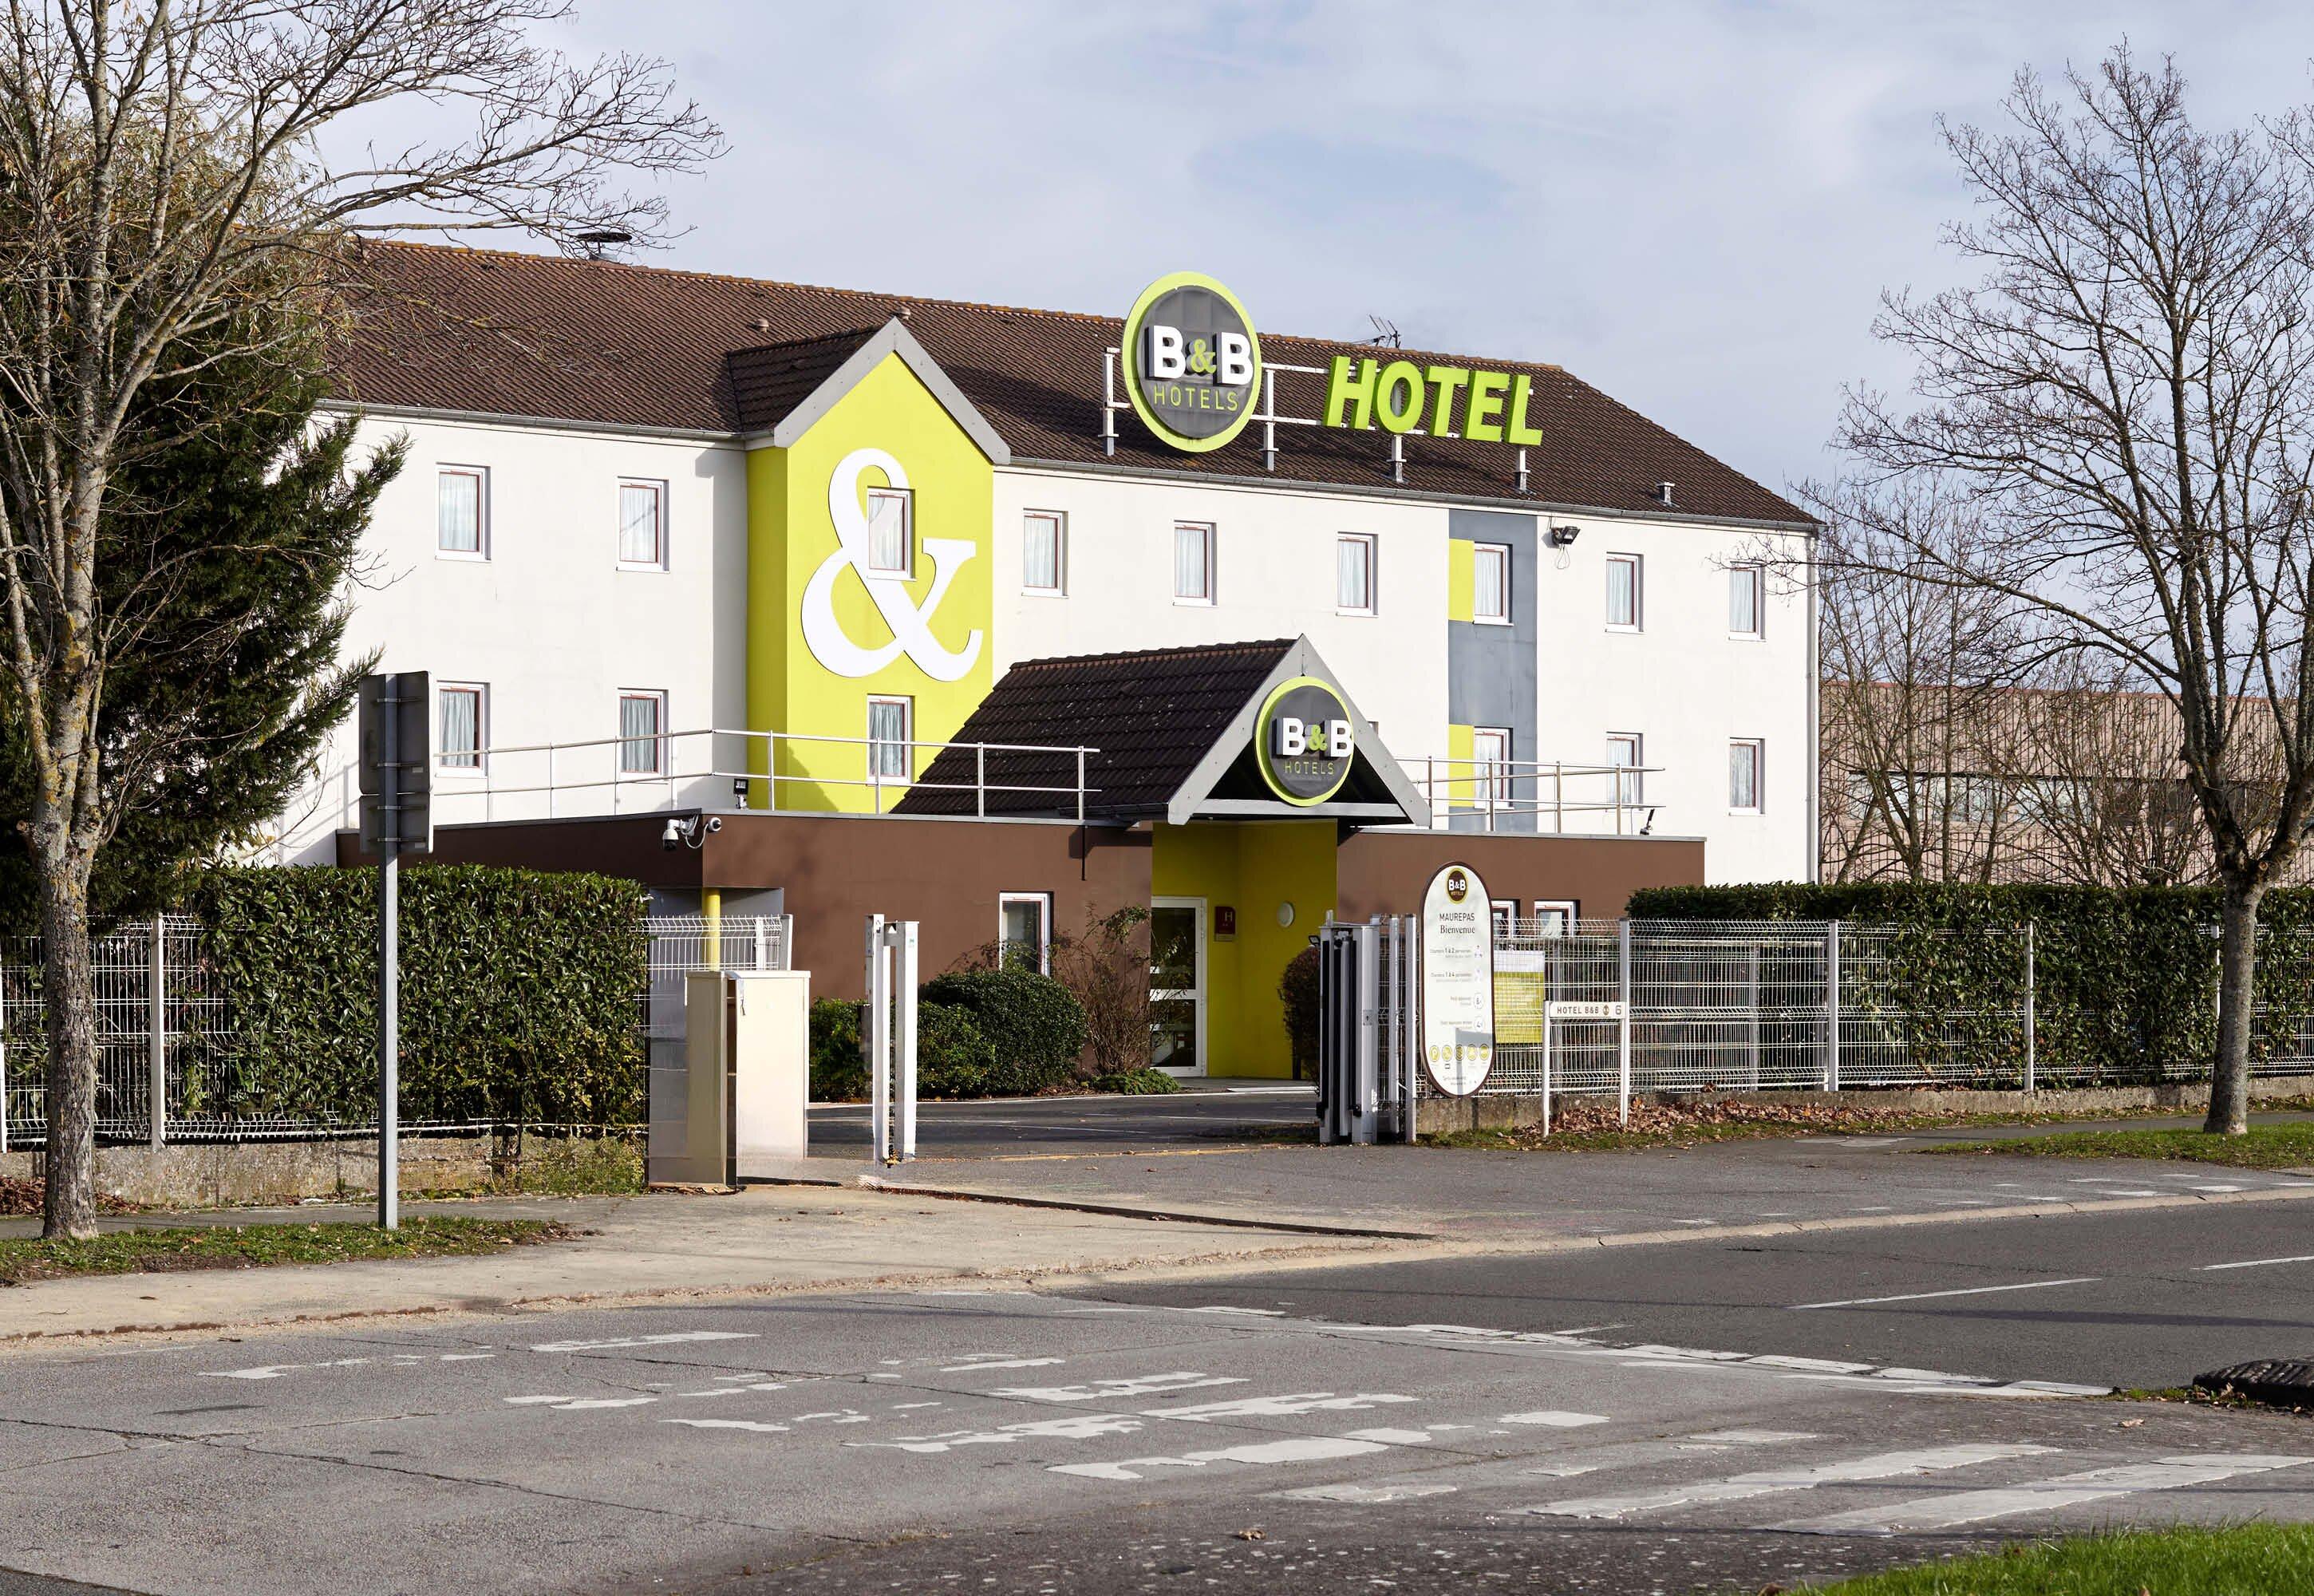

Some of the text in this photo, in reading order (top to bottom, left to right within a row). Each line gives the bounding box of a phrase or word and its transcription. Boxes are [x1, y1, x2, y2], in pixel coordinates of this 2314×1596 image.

[1148, 325, 1254, 385] B&B
[1153, 385, 1239, 412] HOTELS
[1323, 356, 1543, 445] HOTEL
[800, 447, 984, 682] &
[1277, 717, 1353, 757] B&B
[1284, 760, 1335, 775] HOTELS
[1448, 879, 1467, 891] B&B
[1439, 912, 1475, 922] MAUREPAS
[1439, 924, 1475, 934] Bienvenue
[1615, 1005, 1622, 1015] 6
